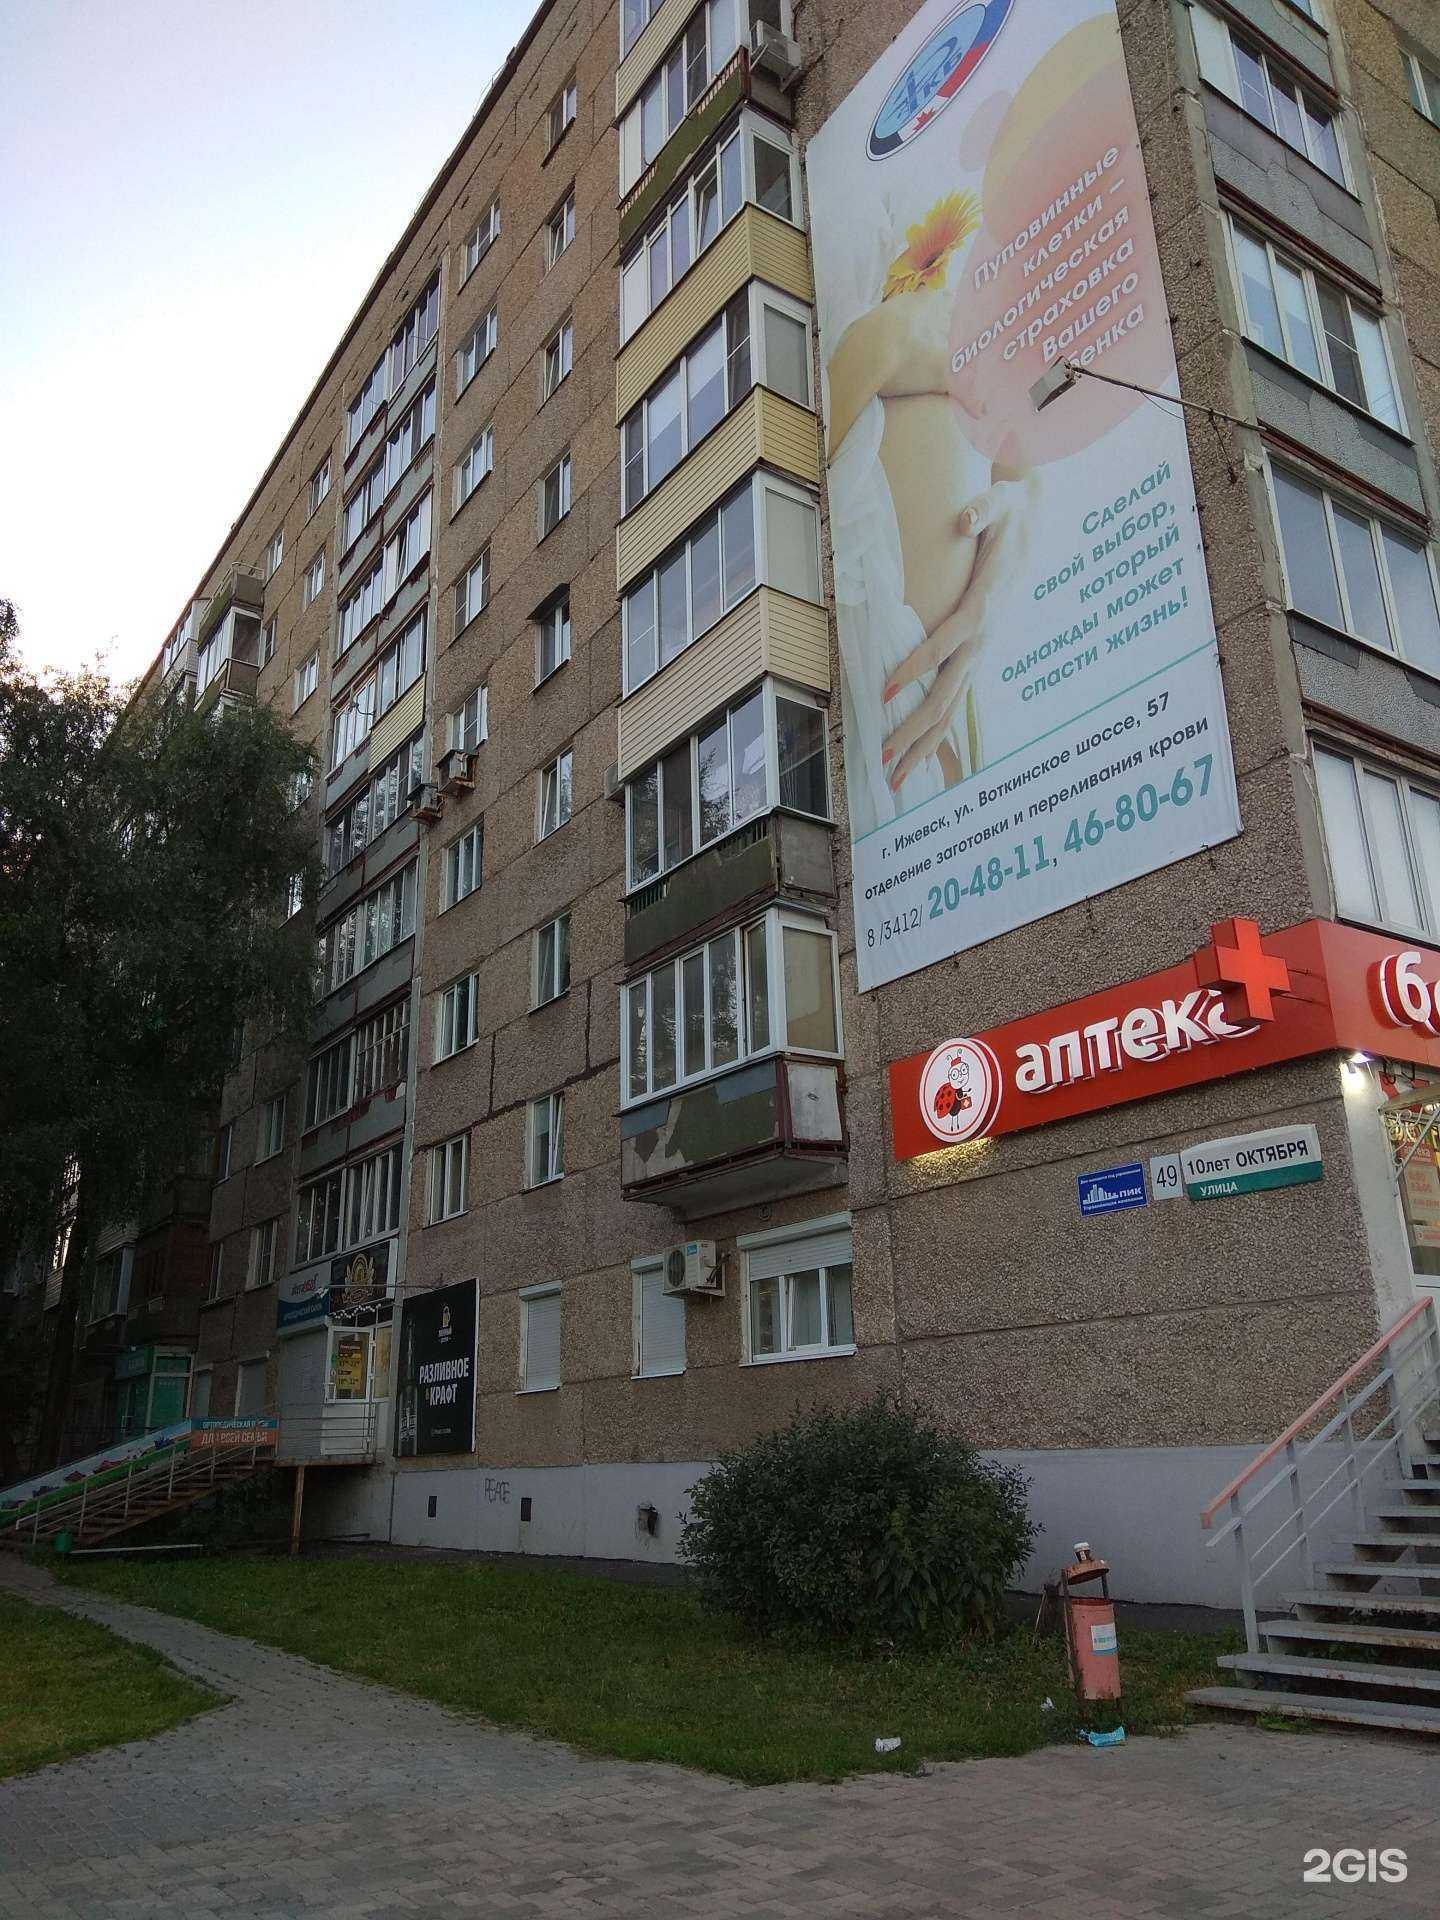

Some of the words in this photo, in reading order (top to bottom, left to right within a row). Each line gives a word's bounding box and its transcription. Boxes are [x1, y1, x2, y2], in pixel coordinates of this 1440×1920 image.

[973, 146, 1120, 289] Пуповинные
[1022, 195, 1103, 278] клетки
[951, 205, 1131, 374] биологическая
[1002, 238, 1135, 362] страховка
[1041, 272, 1140, 363] Вашего
[1082, 460, 1172, 535] Сделай
[1033, 552, 1085, 601] свой
[1091, 501, 1176, 563] выбор,
[1079, 523, 1181, 603] который
[1001, 612, 1099, 683] однажды
[1106, 558, 1185, 619] может
[1021, 645, 1098, 702] спасти
[1104, 585, 1189, 655] жизнь!
[864, 856, 932, 902] отделение
[936, 817, 1010, 869] заготовки
[1013, 812, 1024, 827] и
[1028, 751, 1143, 821] переливания
[1149, 716, 1209, 760] крови
[881, 847, 892, 860] г.
[894, 814, 951, 854] Ижевск,
[954, 804, 975, 829] ул.
[978, 748, 1071, 808] Воткинское
[1076, 714, 1142, 756] шоссе,
[1146, 691, 1170, 718] 57
[866, 926, 876, 950] 8
[927, 835, 1059, 920] 20-48-11,
[1063, 753, 1215, 854] 46-80-67
[1119, 1187, 1142, 1199] ПИК
[1156, 1165, 1178, 1188] 49
[1187, 1158, 1231, 1176] 10лет
[1235, 1139, 1308, 1168] ОКТЯБРЯ
[1200, 1182, 1238, 1197] УЛИЦА
[419, 1356, 470, 1385] РАЗЛИВНОЕ
[430, 1383, 458, 1407] КРАФТ
